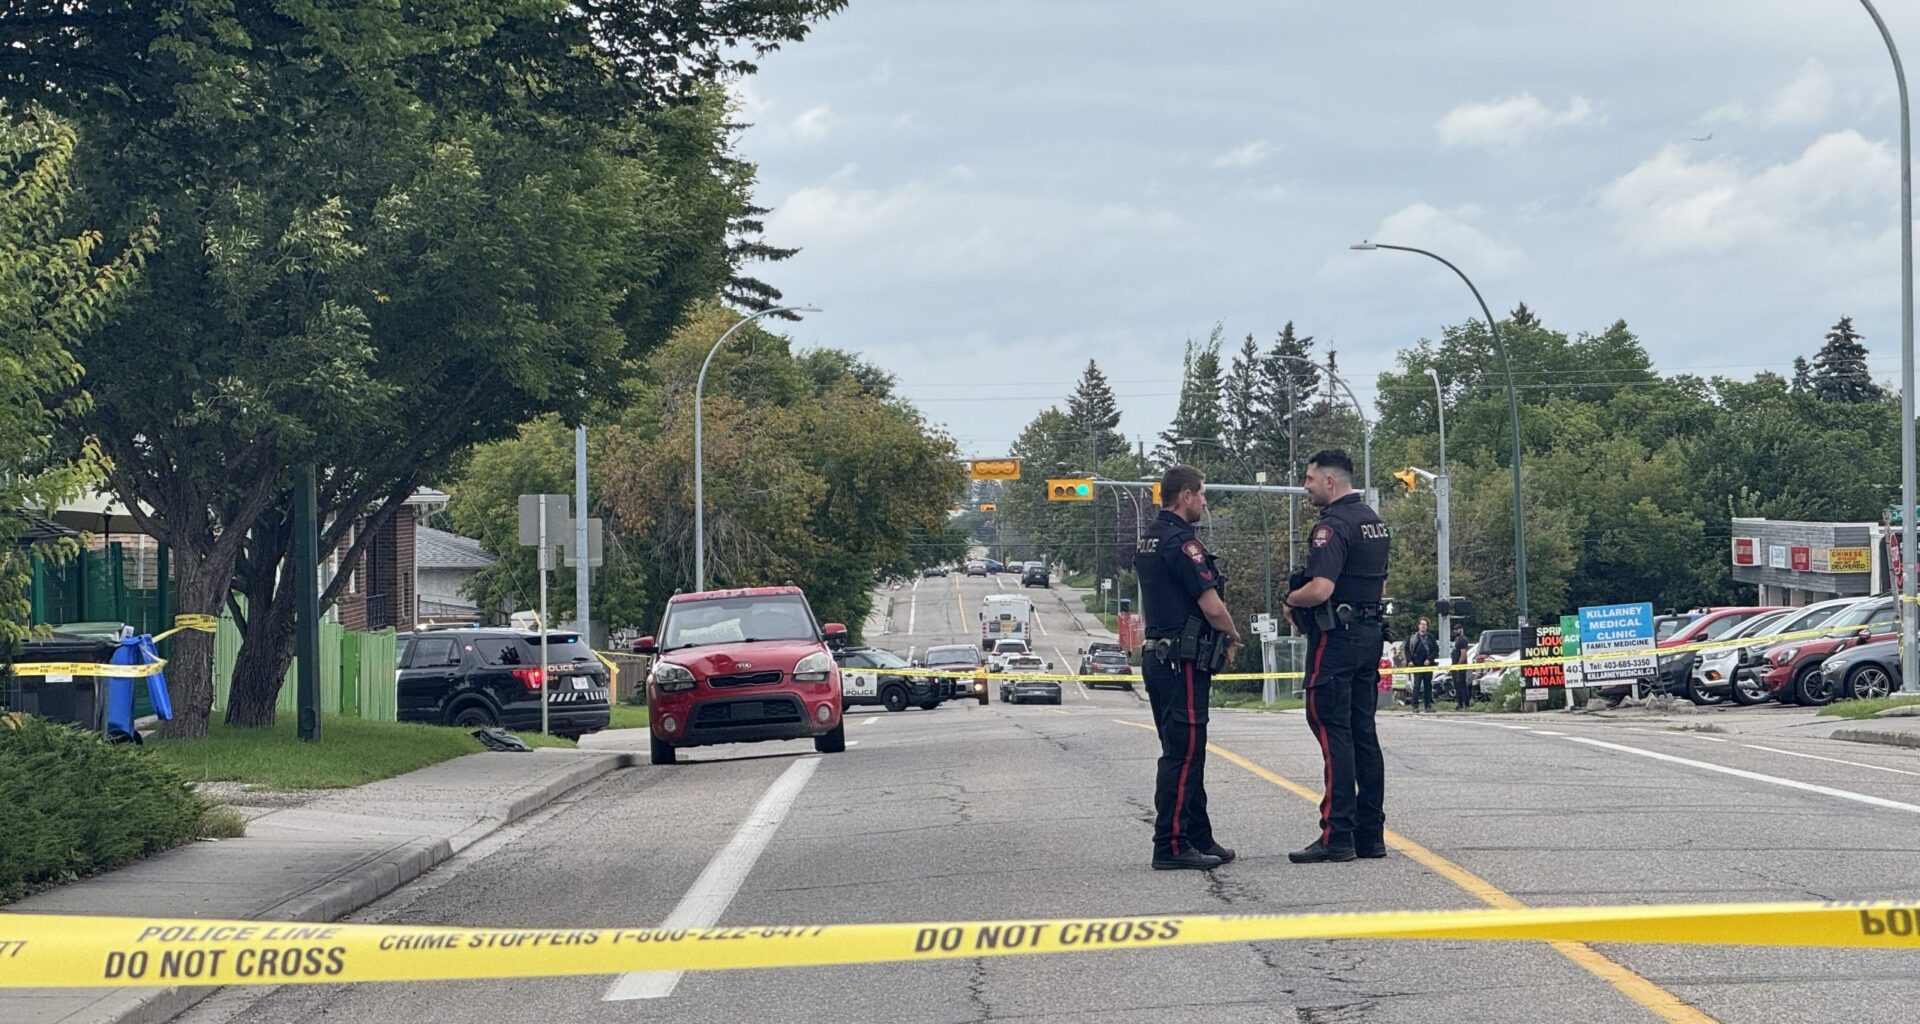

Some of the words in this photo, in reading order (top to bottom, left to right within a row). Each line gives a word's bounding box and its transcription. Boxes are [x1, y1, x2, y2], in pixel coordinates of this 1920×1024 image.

[1361, 523, 1388, 539] POLICE
[1586, 606, 1642, 619] KILLARNEY
[1589, 618, 1642, 630] MEDICAL
[1596, 629, 1637, 640] CLINIC
[1586, 642, 1612, 650] FAMILY
[1613, 639, 1649, 648] MEDICINE
[1525, 647, 1549, 657] NOW
[547, 664, 575, 672] OLICE
[1590, 662, 1602, 670] Tel:
[1603, 658, 1650, 669] 403-685-3350
[136, 926, 260, 942] POLICE
[261, 926, 342, 941] LINE
[914, 927, 963, 953] DO
[974, 923, 1050, 950] NOT
[1056, 919, 1182, 947] CROSS
[379, 932, 463, 951] CRIME
[467, 931, 599, 948] STOPPERS
[104, 951, 149, 979] DO
[159, 949, 226, 977] NOT
[234, 946, 346, 976] CROSS
